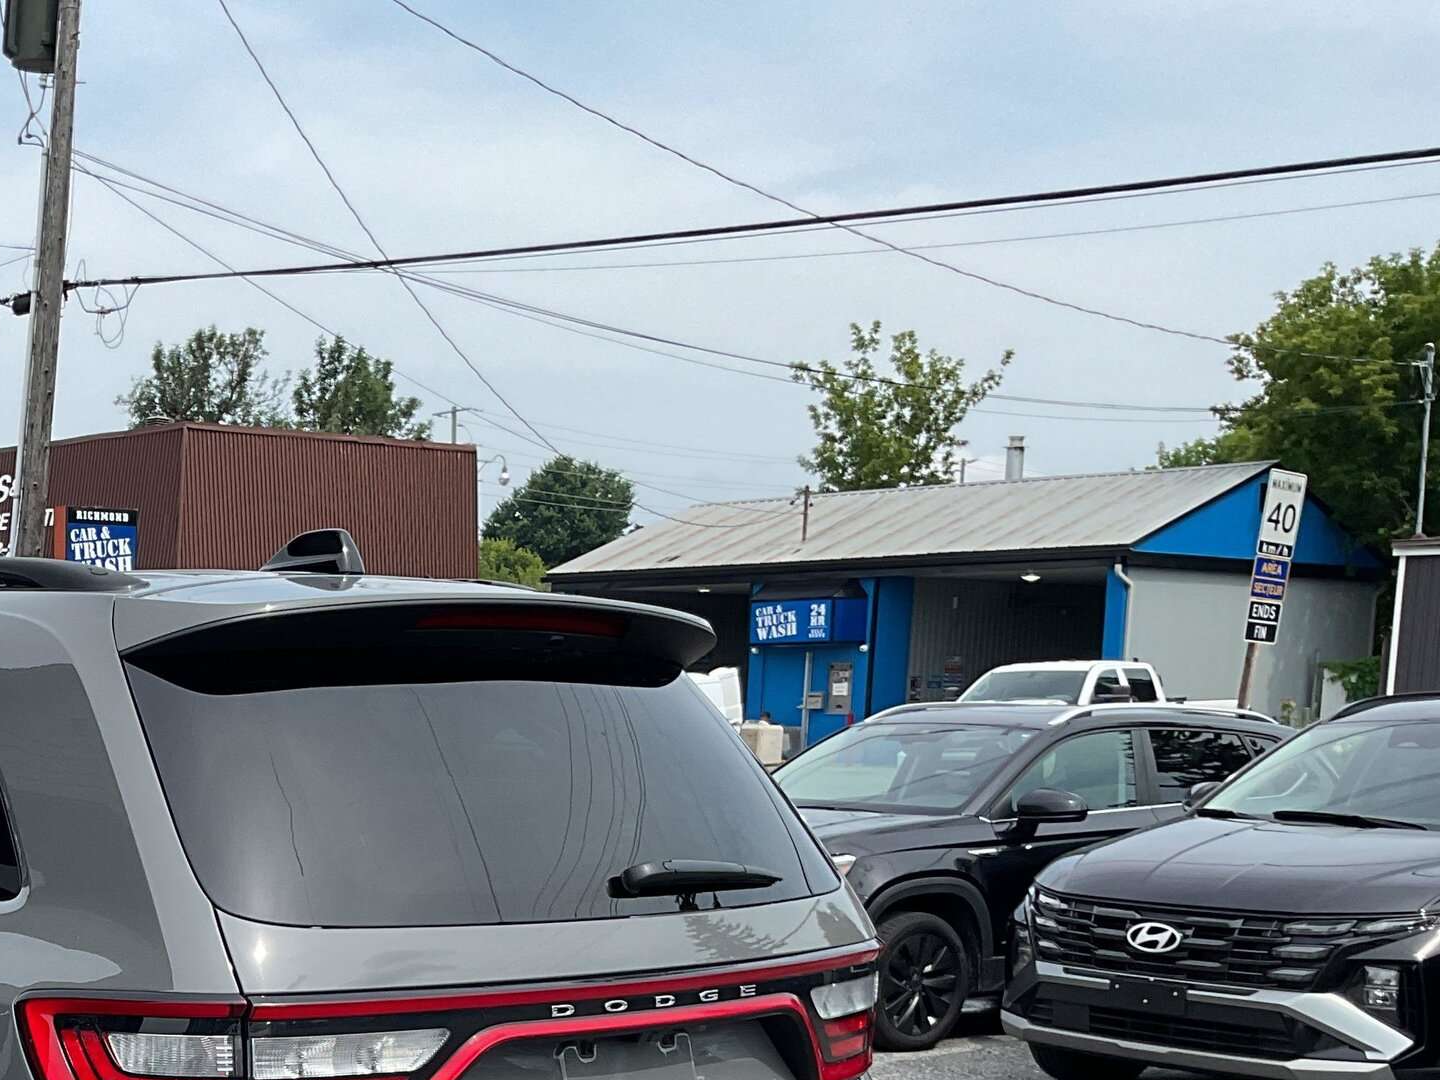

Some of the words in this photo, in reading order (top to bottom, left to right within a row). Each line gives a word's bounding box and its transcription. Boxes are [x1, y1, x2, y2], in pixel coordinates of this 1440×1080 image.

[76, 510, 129, 523] RICHMOND
[1267, 502, 1296, 533] 40
[70, 527, 97, 542] CAR
[100, 526, 111, 540] &
[71, 537, 132, 560] TRUCK
[1262, 542, 1288, 557] km/h
[81, 556, 132, 572] ASH
[1261, 562, 1282, 577] AREA
[1253, 582, 1283, 596] SECTEUR
[756, 606, 773, 617] CAR
[775, 604, 783, 613] &
[810, 603, 826, 616] 24
[1251, 603, 1277, 620] ENDS
[756, 610, 796, 627] TRUCK
[810, 615, 825, 626] HR
[756, 622, 797, 640] WASH
[1253, 625, 1268, 640] FIN
[551, 984, 757, 1018] DODGE
